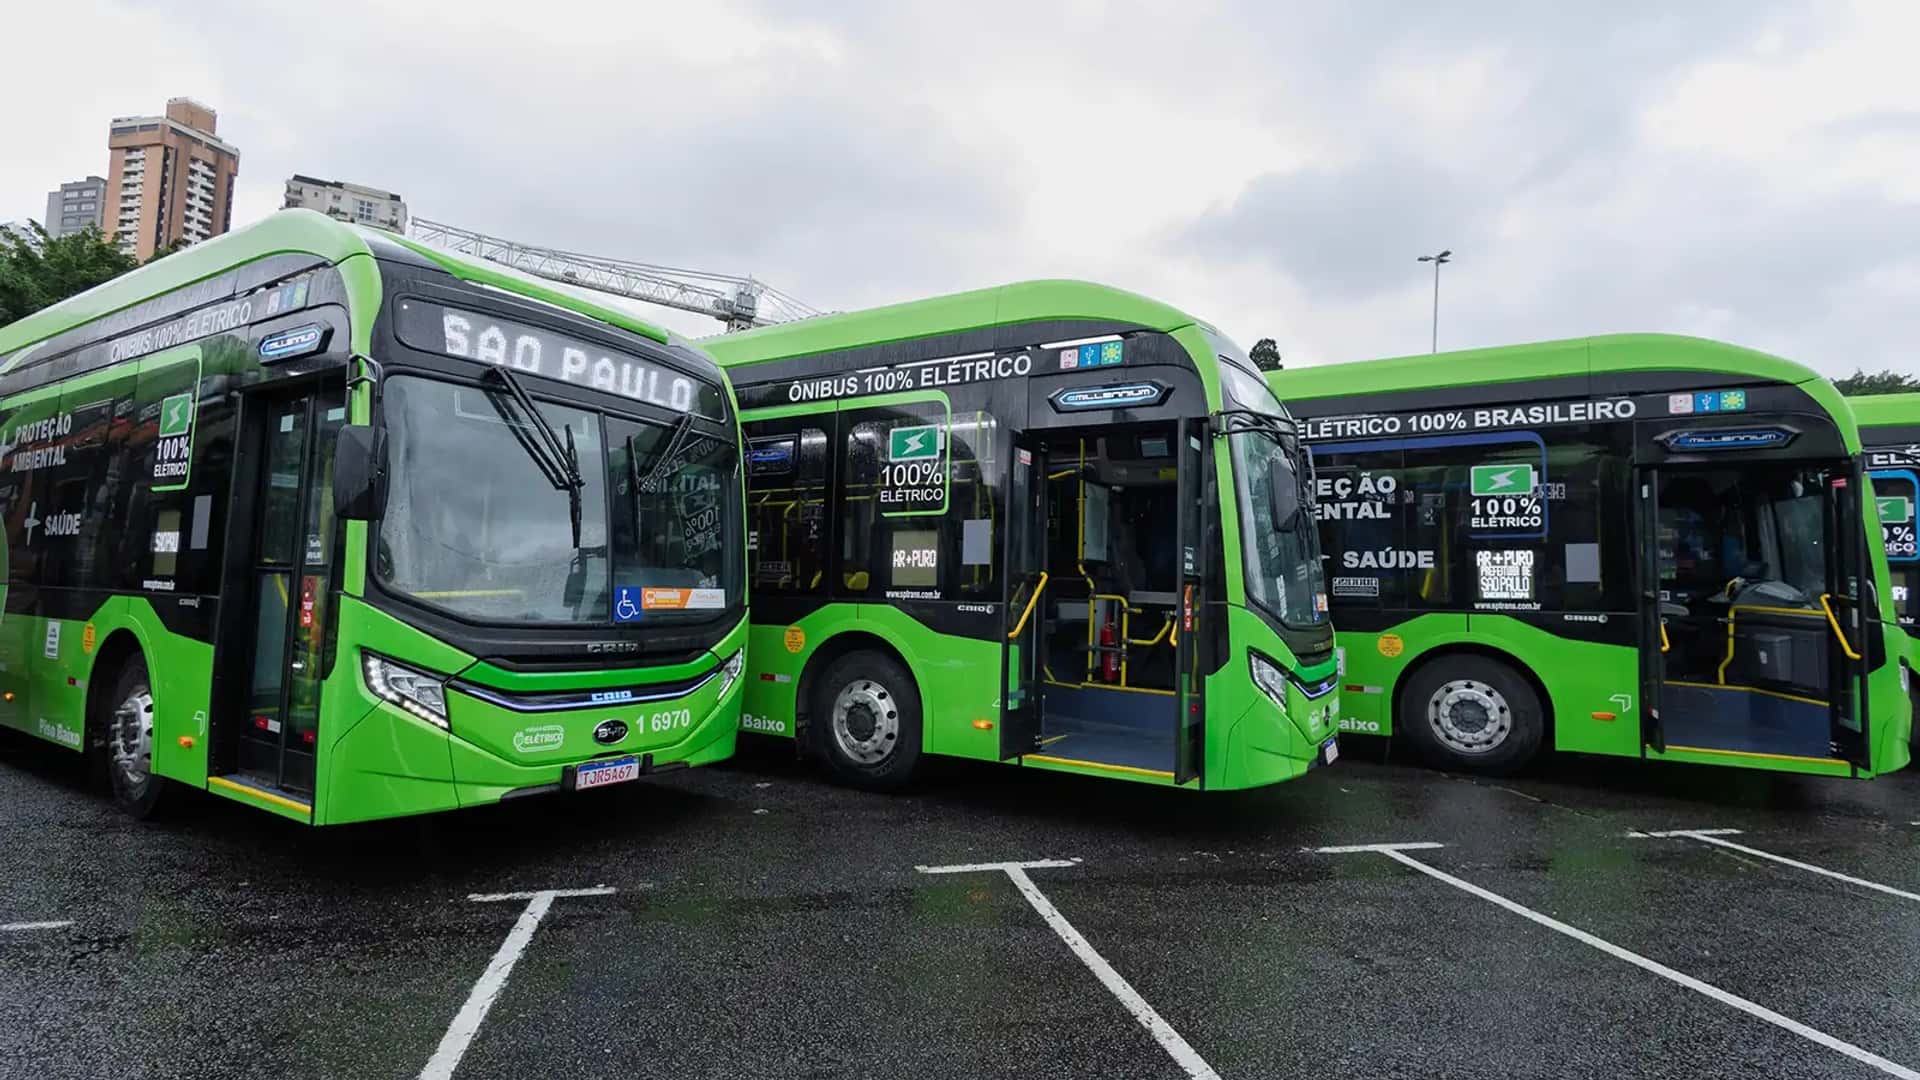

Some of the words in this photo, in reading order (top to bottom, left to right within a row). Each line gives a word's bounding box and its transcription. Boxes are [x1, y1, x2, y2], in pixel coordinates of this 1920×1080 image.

[153, 322, 183, 349] 100%
[561, 347, 692, 412] PAULO
[788, 377, 858, 402] ÔNIBUS
[864, 370, 914, 393] 100%
[920, 355, 1032, 387] ELÉTRICO
[15, 411, 72, 443] PROTEÇÃO
[1297, 417, 1401, 440] ELÉTRICO
[1408, 411, 1467, 432] 100%
[1474, 399, 1636, 427] BRASILEIRO
[11, 445, 66, 472] AMBIENTAL
[156, 436, 190, 460] 100%
[153, 461, 188, 478] ELÉTRICO
[881, 461, 944, 487] 100%
[880, 484, 944, 503] ELÉTRICO
[1316, 472, 1397, 500] EÇÃO
[1314, 501, 1392, 520] ENTAL
[1471, 497, 1541, 515] 100%
[45, 509, 81, 536] SAÚDE
[1471, 514, 1541, 528] ELÉTRICO
[1343, 546, 1435, 569] SAÚDE
[885, 589, 941, 600] www.sptrans.com.br
[1473, 601, 1542, 612] www.sptrans.com.br
[635, 715, 645, 735] 1
[651, 708, 691, 732] 6970
[742, 713, 786, 732] Baixo
[1339, 717, 1380, 732] aixo
[583, 765, 633, 786] TJR5A67
